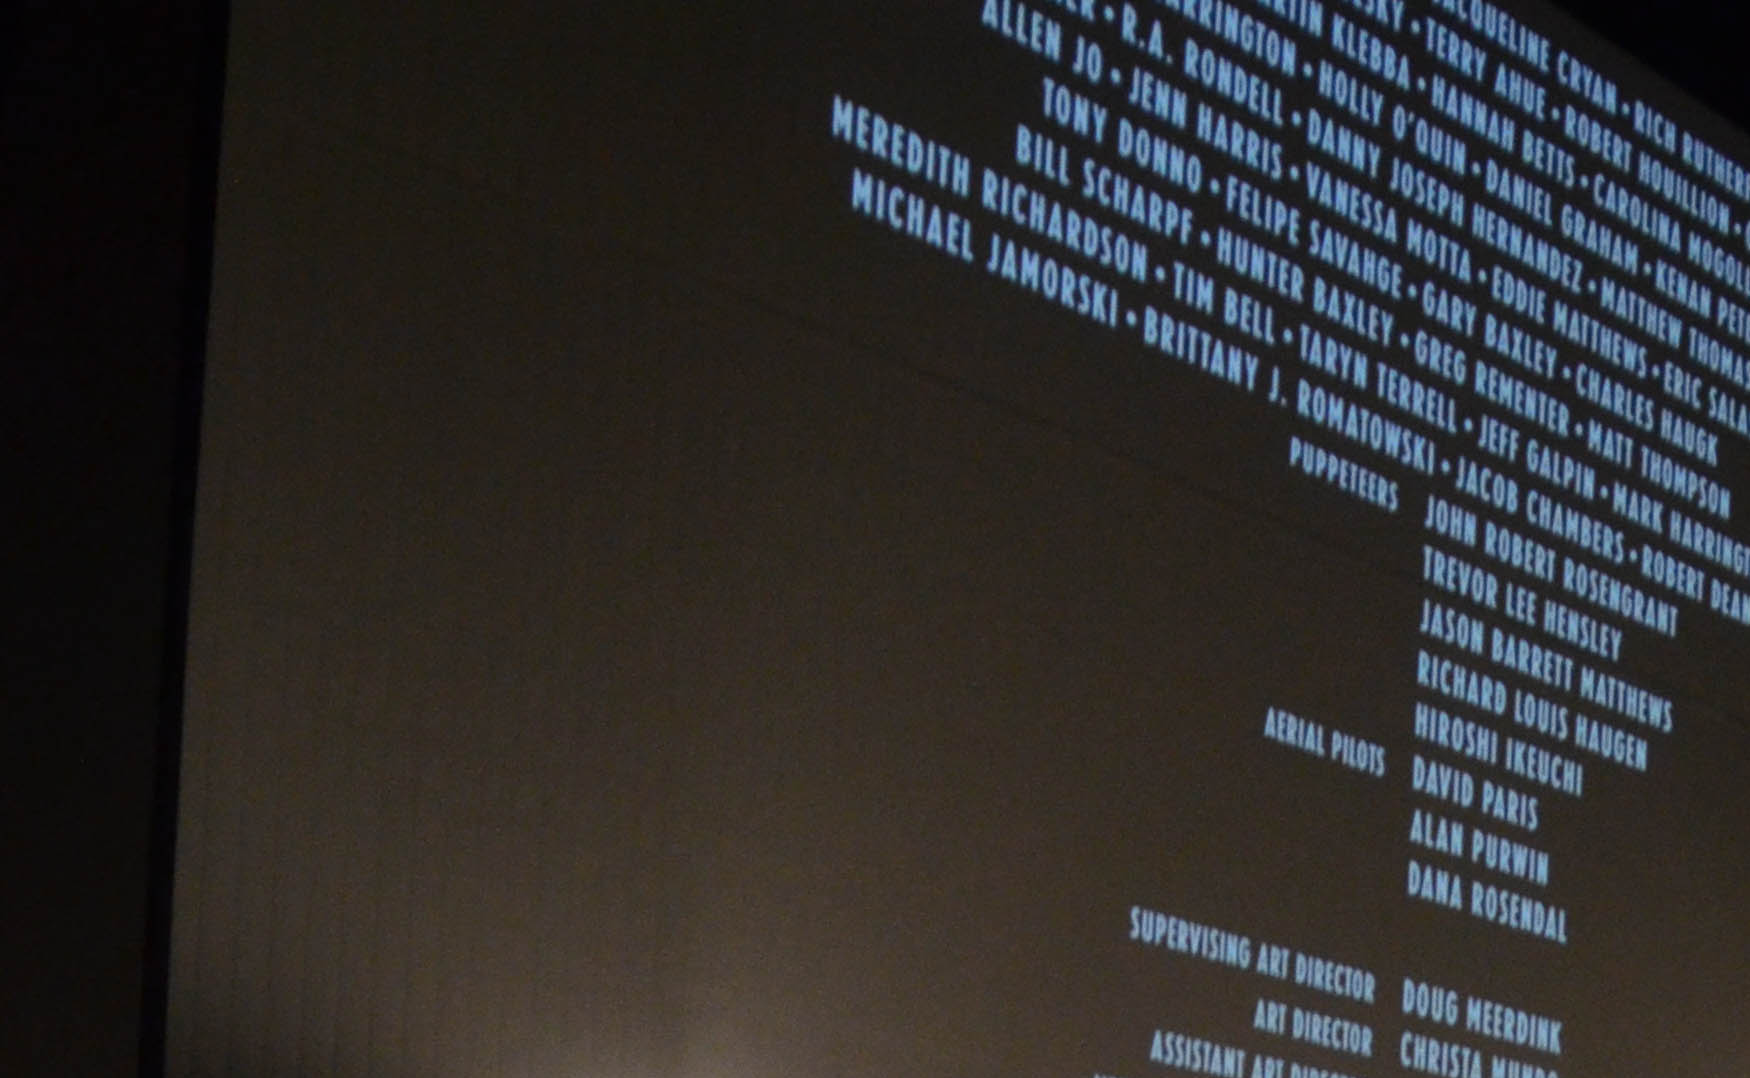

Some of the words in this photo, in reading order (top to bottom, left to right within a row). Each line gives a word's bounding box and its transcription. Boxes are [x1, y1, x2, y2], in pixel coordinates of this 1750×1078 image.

[980, 0, 1061, 61] ALLEN
[1072, 37, 1105, 83] JO
[1127, 68, 1187, 126] JENN
[1195, 106, 1283, 180] HARRIS
[1305, 163, 1398, 241] VANESSA
[1406, 220, 1473, 281] MOTTA
[1490, 266, 1547, 321] EDDIE
[1551, 300, 1648, 377] MATTHEWS
[1660, 362, 1702, 409] ERIC
[1042, 77, 1107, 142] TONY
[1117, 119, 1204, 193] DONNO
[1225, 175, 1299, 245] FELIPE
[1421, 280, 1476, 331] GARY
[1484, 314, 1558, 376] BAXLEY
[1574, 364, 1655, 433] CHARLES
[1306, 111, 1381, 171] DANNY
[1389, 159, 1465, 225] JOSEPH
[1471, 204, 1584, 294] HERNANDEZ
[1601, 278, 1683, 346] MATTHEW
[831, 96, 971, 196] MEREDITH
[981, 170, 1147, 281] RICHARDSON
[1172, 263, 1214, 312] TIM
[1223, 288, 1273, 344] BELL
[1299, 324, 1368, 387] TARYN
[1377, 363, 1457, 433] TERRELL
[1479, 417, 1518, 460] JEFF
[1612, 483, 1664, 532] MARK
[1014, 125, 1069, 187] BILL
[1081, 158, 1192, 244] SCHARPF
[1215, 228, 1303, 300] HUNTER
[1312, 276, 1393, 343] BAXLEY
[1411, 330, 1465, 385] GREG
[1474, 362, 1570, 436] REMENTER
[1586, 421, 1633, 465] MATT
[1640, 446, 1731, 516] THOMPSON
[850, 172, 973, 264] MICHAEL
[986, 235, 1117, 327] JAMORSKI
[1143, 307, 1258, 388] BRITTANY
[1268, 366, 1287, 407] J.
[1296, 379, 1434, 472] ROMATOWSKI
[1455, 458, 1519, 513] JACOB
[1527, 489, 1625, 565] CHAMBERS
[1640, 545, 1705, 598] ROBERT
[1289, 436, 1400, 511] PUPPETEERS
[1423, 498, 1477, 544] JOHN
[1484, 522, 1555, 580] ROBERT
[1563, 557, 1678, 633] ROSENGRANT
[1423, 547, 1498, 608] TREVOR
[1504, 585, 1536, 625] LEE
[1543, 603, 1623, 660] HENSLEY
[1416, 652, 1507, 714] RICHARD
[1513, 692, 1568, 737] LOUIS
[1574, 716, 1648, 770] HAUGEN
[1419, 603, 1484, 652] JASON
[1491, 628, 1574, 689] BARRETT
[1579, 668, 1673, 732] MATTHEWS
[1263, 707, 1325, 756] AERIAL
[1330, 731, 1385, 777] PILOTS
[1411, 756, 1474, 808] DAVID
[1481, 783, 1541, 831] PARIS
[1413, 704, 1499, 762] HIROSHI
[1506, 740, 1583, 795] IKEUCHI
[1409, 810, 1465, 856] ALAN
[1471, 831, 1550, 884] PURWIN
[1128, 906, 1249, 968] SUPERVISING
[1256, 945, 1290, 977] ART
[1293, 953, 1376, 1002] DIRECTOR
[1406, 861, 1463, 908] DANA
[1471, 884, 1567, 945] ROSENDAL
[1150, 1031, 1245, 1078] ASSISTANT
[1253, 1000, 1288, 1033] ART
[1290, 1008, 1373, 1057] DIRECTOR
[1401, 978, 1458, 1025] DOUG
[1466, 999, 1562, 1053] MEERDINK
